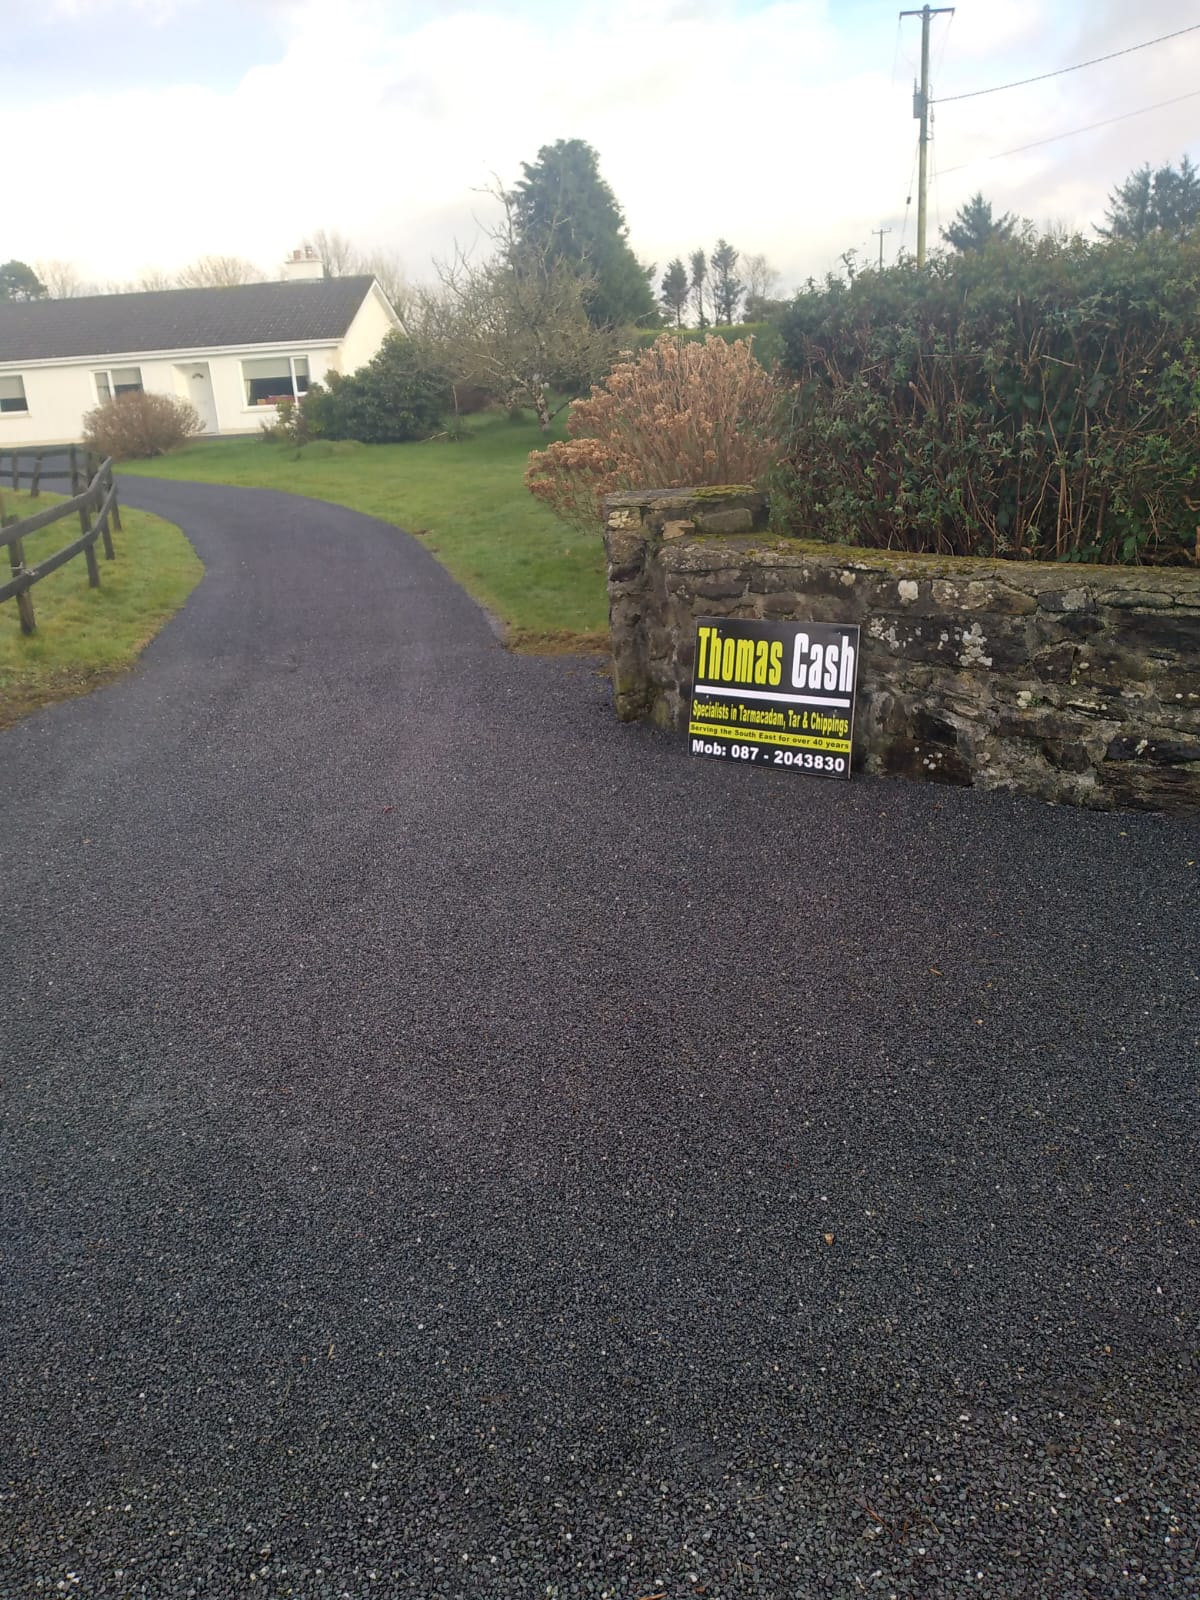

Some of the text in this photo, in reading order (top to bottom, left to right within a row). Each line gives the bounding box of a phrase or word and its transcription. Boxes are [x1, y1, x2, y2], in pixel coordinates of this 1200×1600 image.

[698, 627, 855, 692] Thomas Cash
[693, 699, 849, 737] Specialists in Tarmacadam, Tar & Chippings
[691, 724, 849, 750] Serving the South East for over 40 years
[692, 739, 726, 756] Mob:
[731, 744, 759, 761] 087
[773, 750, 845, 772] 2043830
